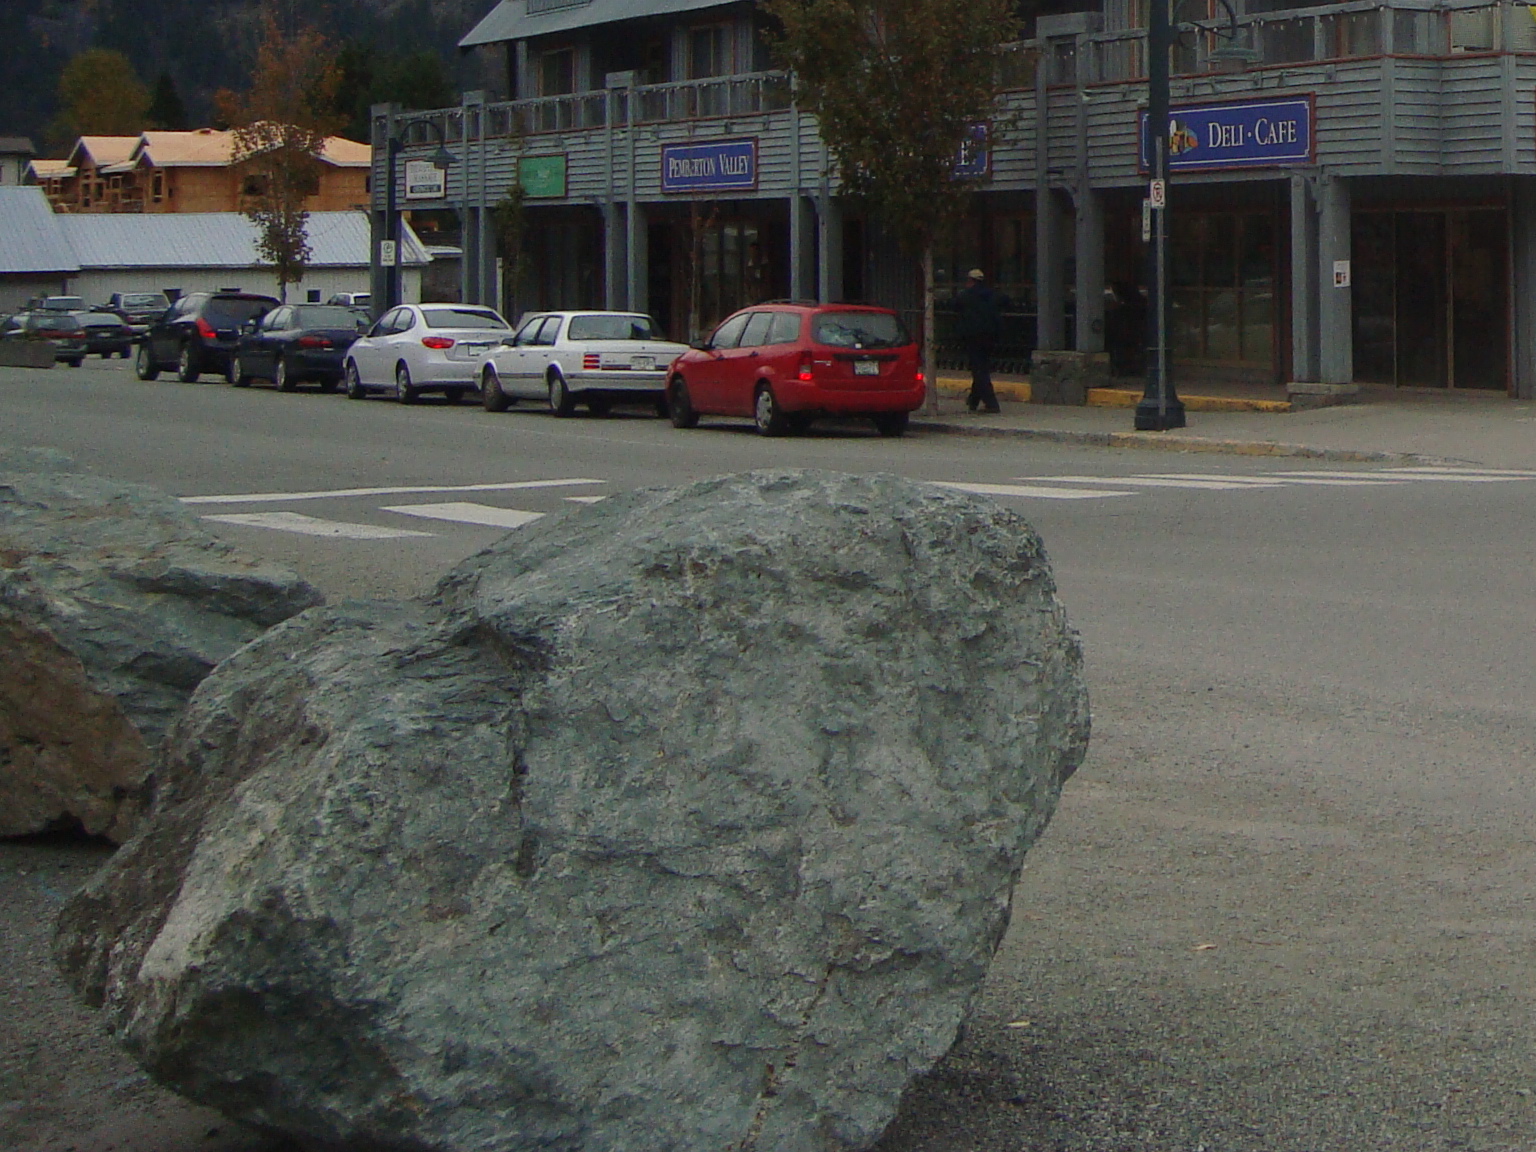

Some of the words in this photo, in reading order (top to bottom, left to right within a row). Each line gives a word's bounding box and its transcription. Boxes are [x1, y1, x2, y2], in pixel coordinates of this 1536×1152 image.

[1208, 122, 1244, 148] DELI
[1254, 118, 1297, 145] CAFE
[668, 157, 716, 179] PEMBERTON
[719, 153, 749, 176] VALLEY
